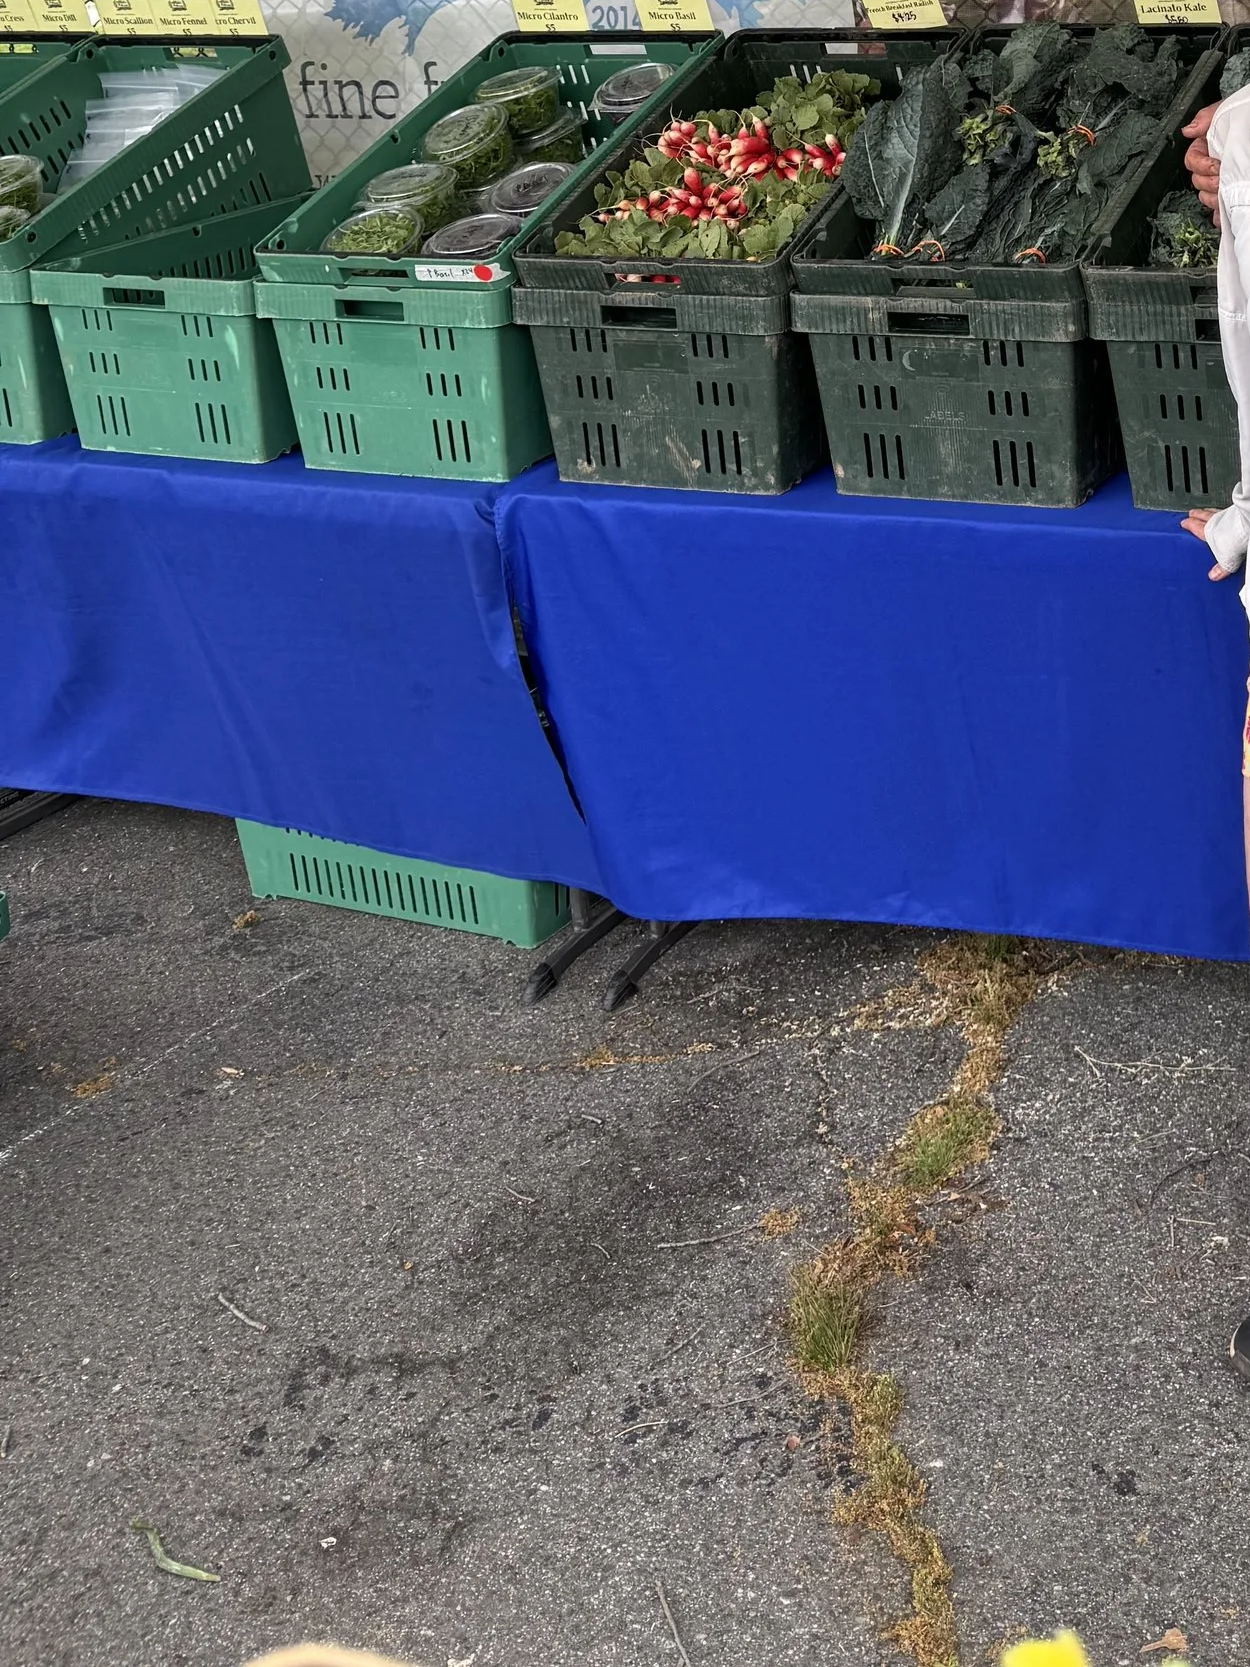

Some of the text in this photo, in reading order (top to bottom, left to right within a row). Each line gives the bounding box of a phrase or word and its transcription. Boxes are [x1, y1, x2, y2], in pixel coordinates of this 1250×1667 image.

[866, 6, 886, 14] French
[886, 2, 913, 12] Breakfast
[914, 0, 934, 7] Radish
[1140, 3, 1207, 13] Lacinato Kale
[42, 14, 77, 22] Micro Dill
[228, 16, 256, 24] Chervil
[517, 11, 579, 21] Micro Cilantro
[649, 10, 696, 20] Micro Basil
[103, 16, 153, 25] Micro Scallion
[159, 17, 208, 25] Micro Fennel
[299, 61, 399, 119] fine
